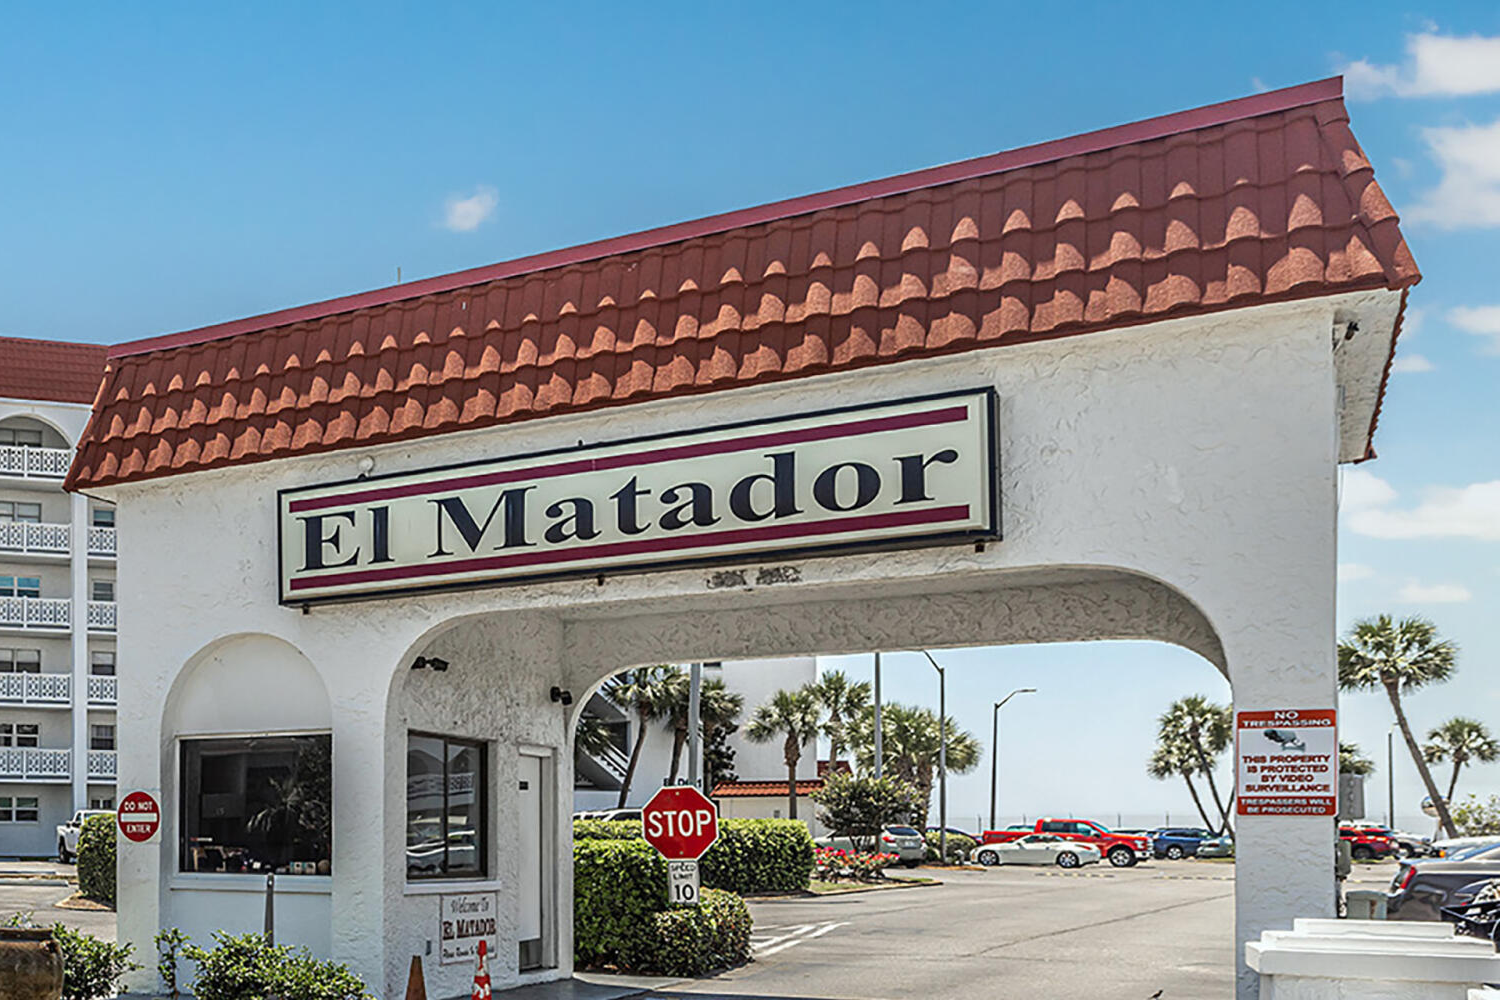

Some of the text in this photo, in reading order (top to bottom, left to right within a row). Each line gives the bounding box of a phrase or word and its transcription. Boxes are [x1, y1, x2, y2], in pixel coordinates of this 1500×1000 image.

[295, 448, 960, 573] El Matador
[1274, 710, 1299, 719] NO
[1242, 719, 1331, 727] TRESPASSING
[1242, 755, 1330, 763] THIS PROPERTY
[1247, 764, 1328, 773] IS PROTECTED
[1279, 774, 1314, 782] VIDEO
[1245, 784, 1330, 792] SURVEILLANCE
[124, 801, 152, 811] DO NOT
[648, 810, 711, 837] STOP
[126, 824, 151, 833] ENTER
[671, 864, 696, 872] SPEED
[672, 873, 694, 881] LIMIT
[674, 884, 695, 901] 10
[456, 918, 496, 938] MATADOR
